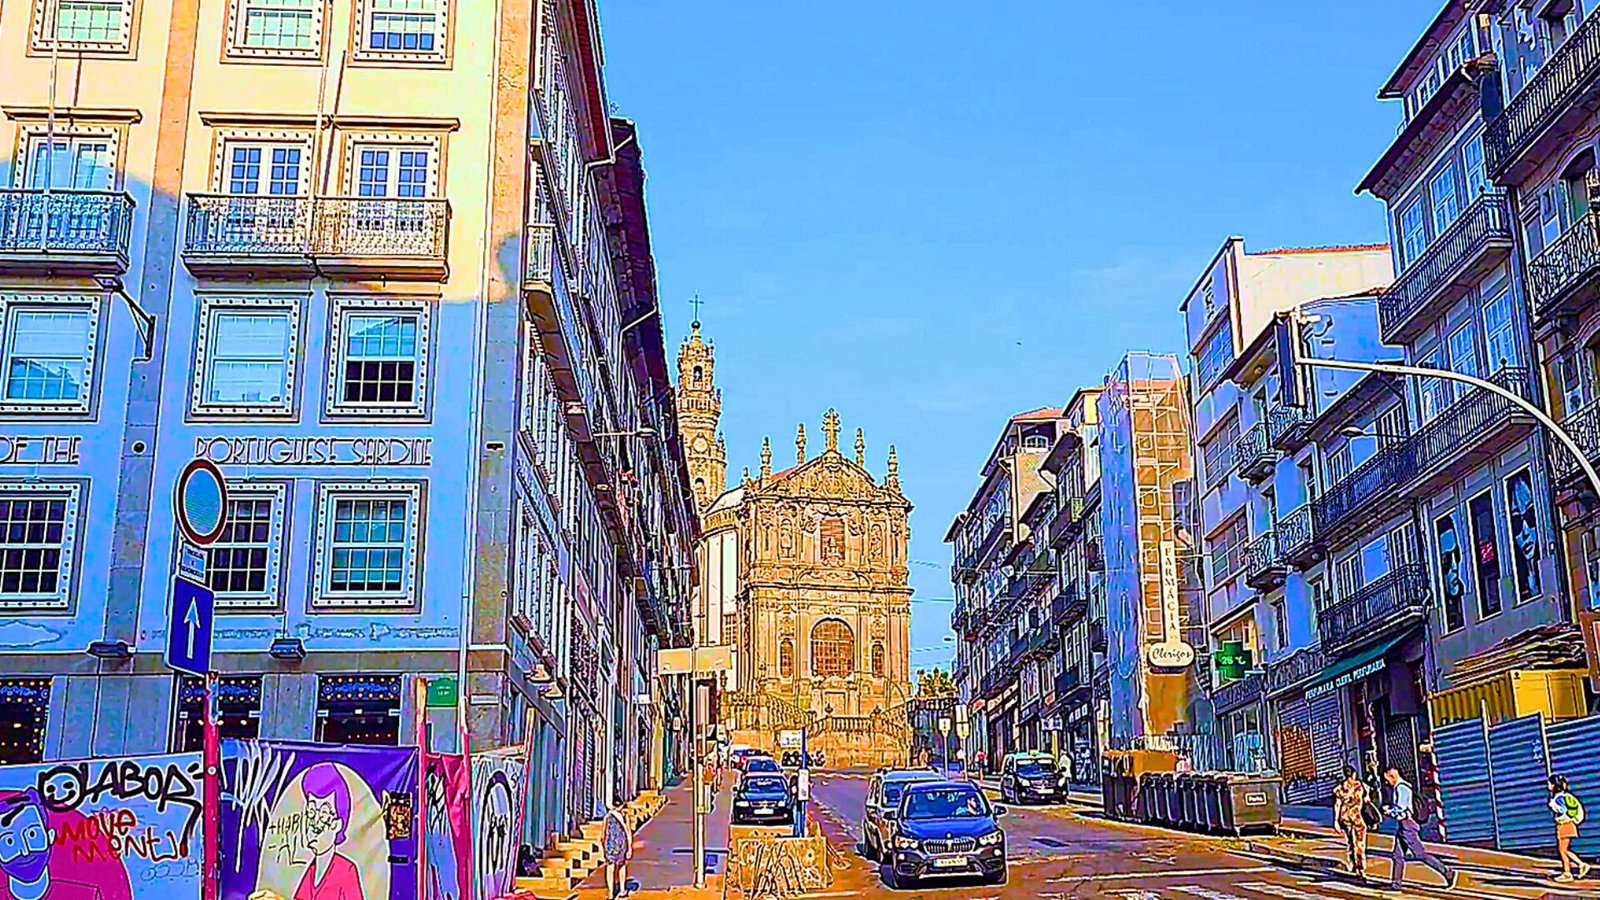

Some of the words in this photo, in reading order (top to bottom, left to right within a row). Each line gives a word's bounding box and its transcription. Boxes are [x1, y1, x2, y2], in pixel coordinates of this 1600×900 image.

[43, 436, 82, 464] THE
[195, 437, 337, 465] PORTUGUESE
[353, 438, 432, 466] SARDINE
